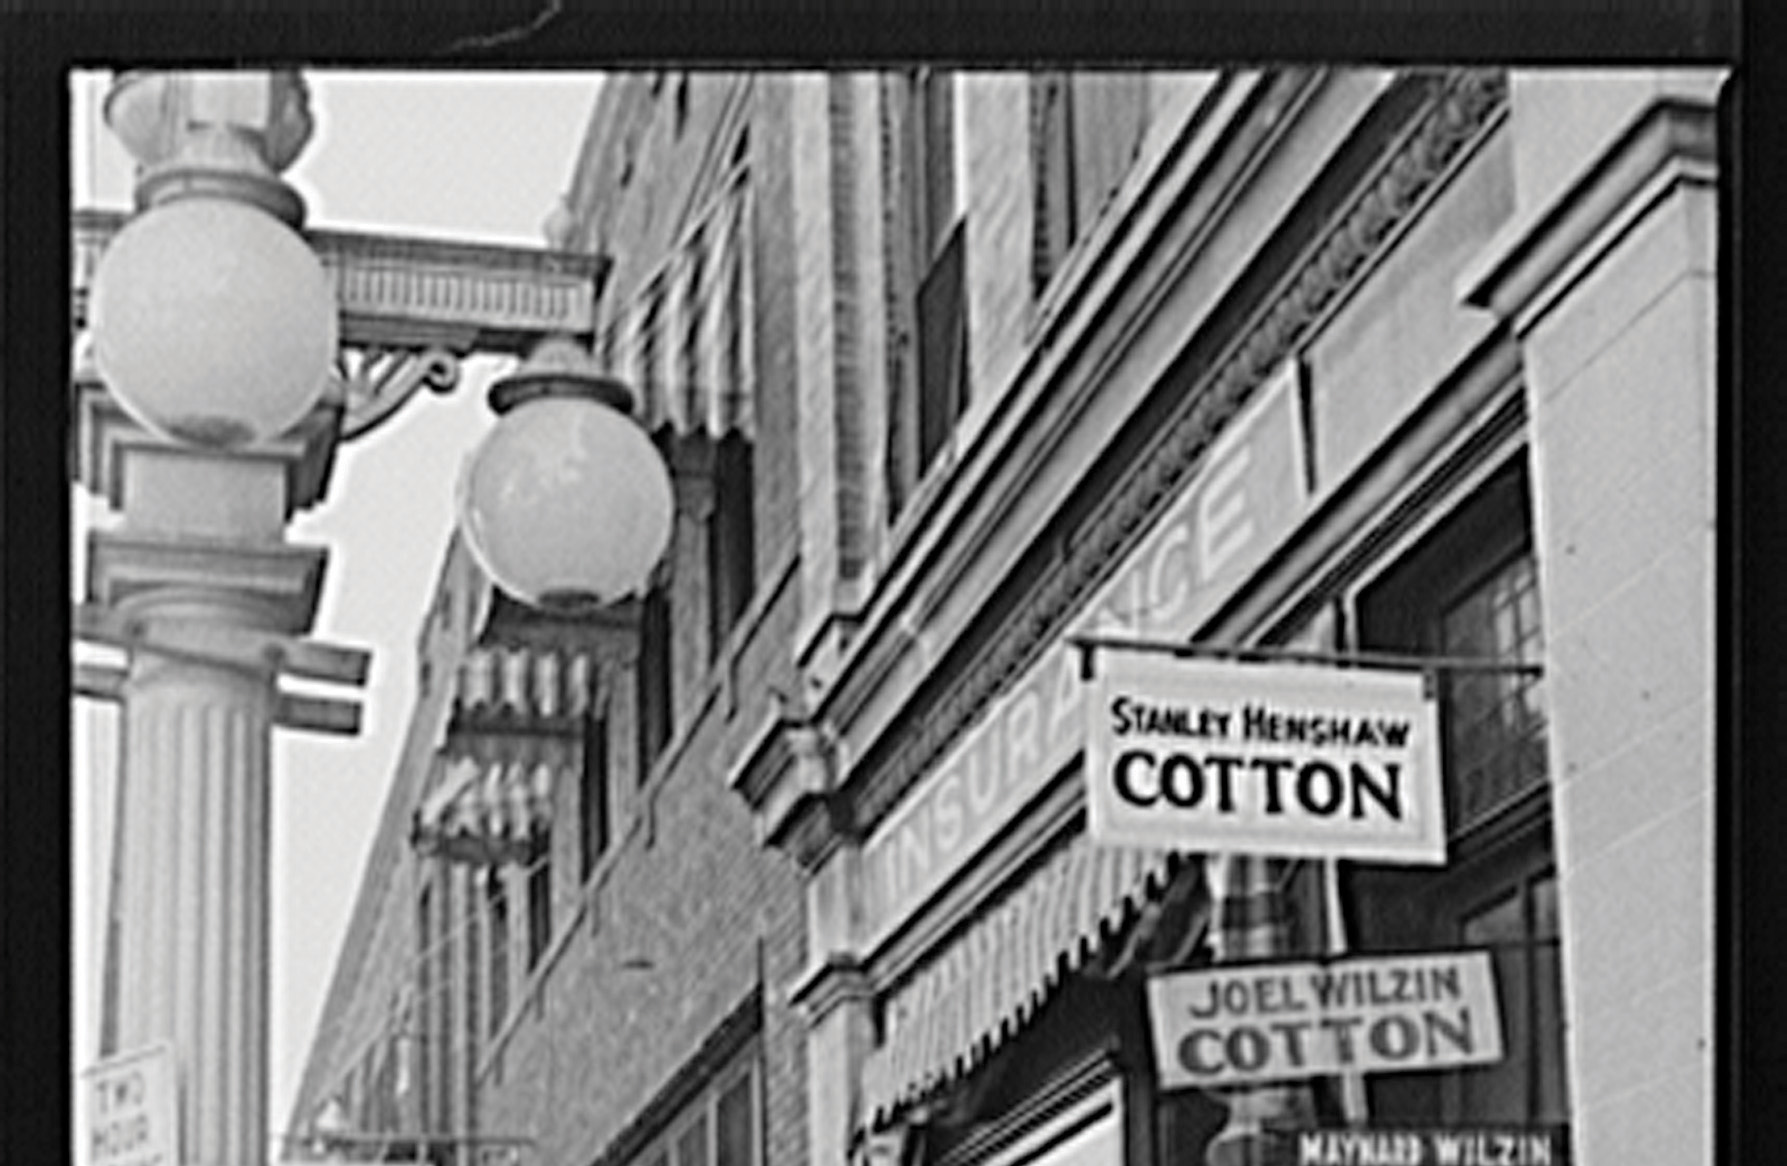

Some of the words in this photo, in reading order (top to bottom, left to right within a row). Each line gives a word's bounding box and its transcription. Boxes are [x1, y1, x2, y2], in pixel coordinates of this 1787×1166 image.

[1113, 750, 1403, 820] COTTON
[1188, 976, 1306, 1019] JOEL
[1310, 966, 1460, 1010] WILZIN
[1177, 1008, 1474, 1076] COTTON
